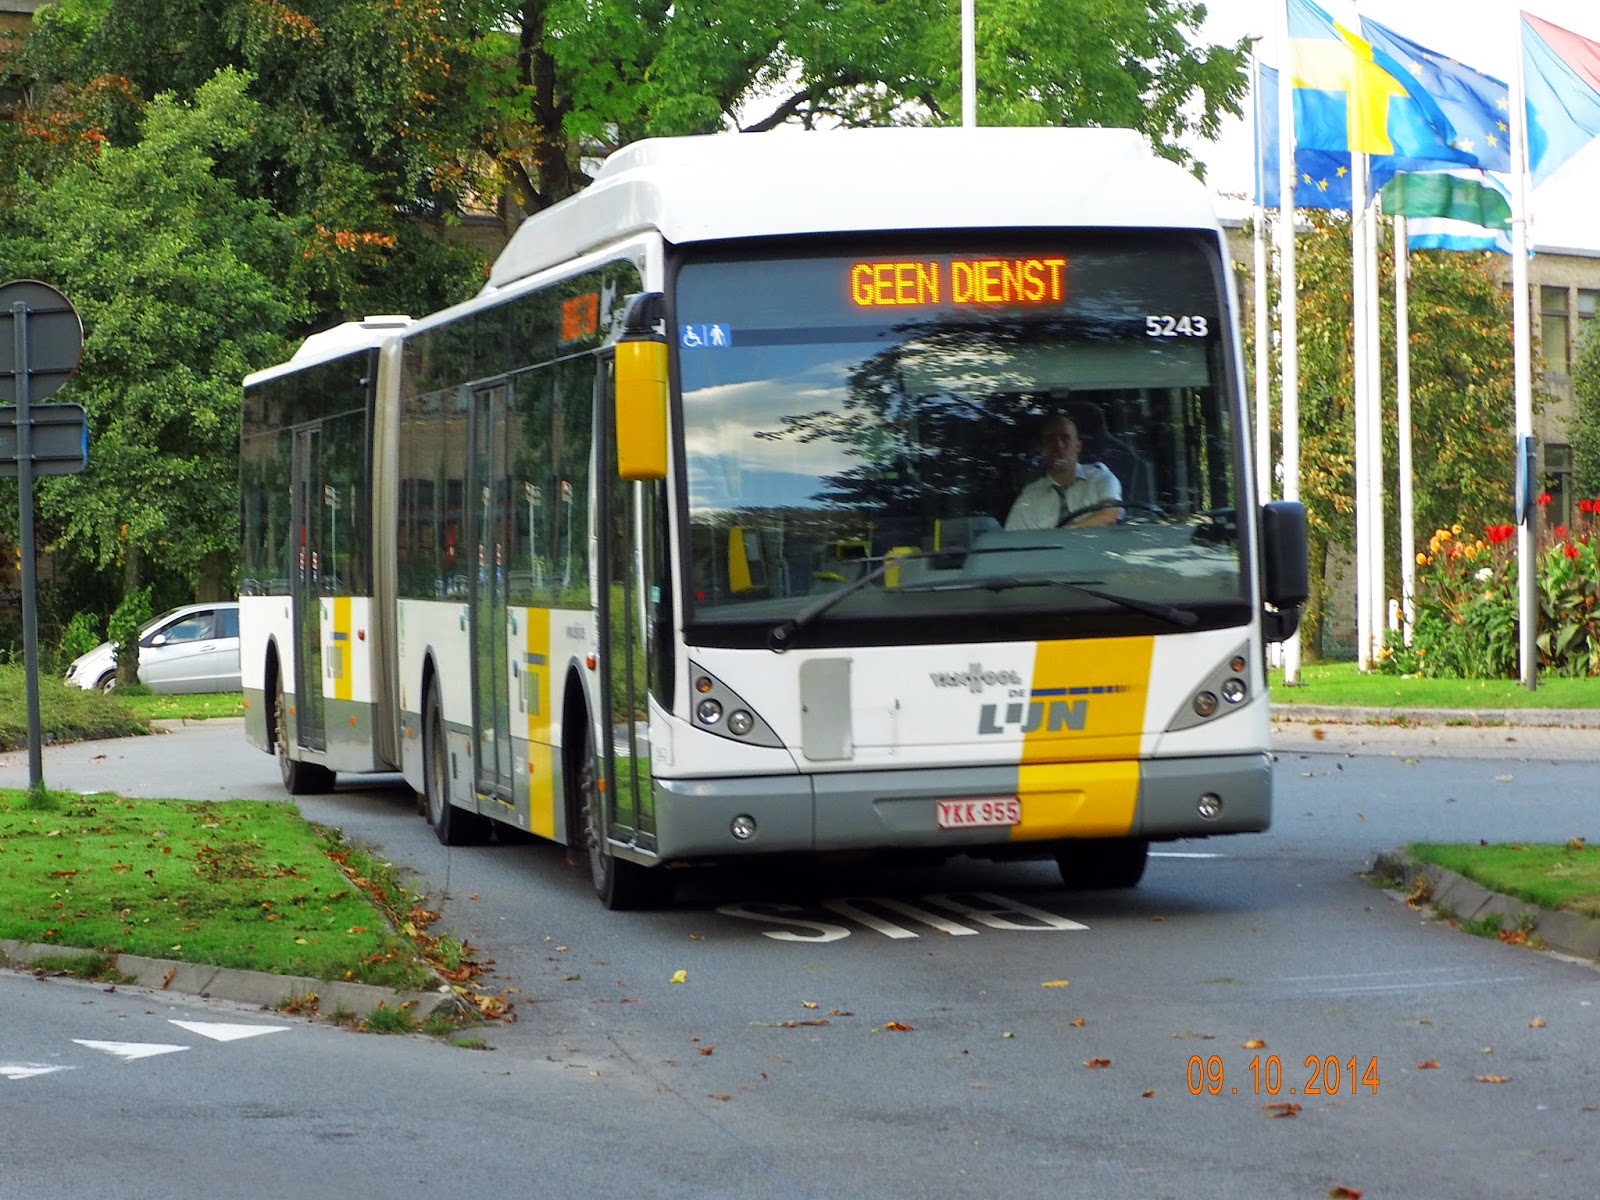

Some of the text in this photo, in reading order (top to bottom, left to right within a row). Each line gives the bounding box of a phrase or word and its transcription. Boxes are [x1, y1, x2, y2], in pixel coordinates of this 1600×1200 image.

[851, 259, 1067, 305] GEEN DIENST
[1145, 315, 1209, 337] 5243
